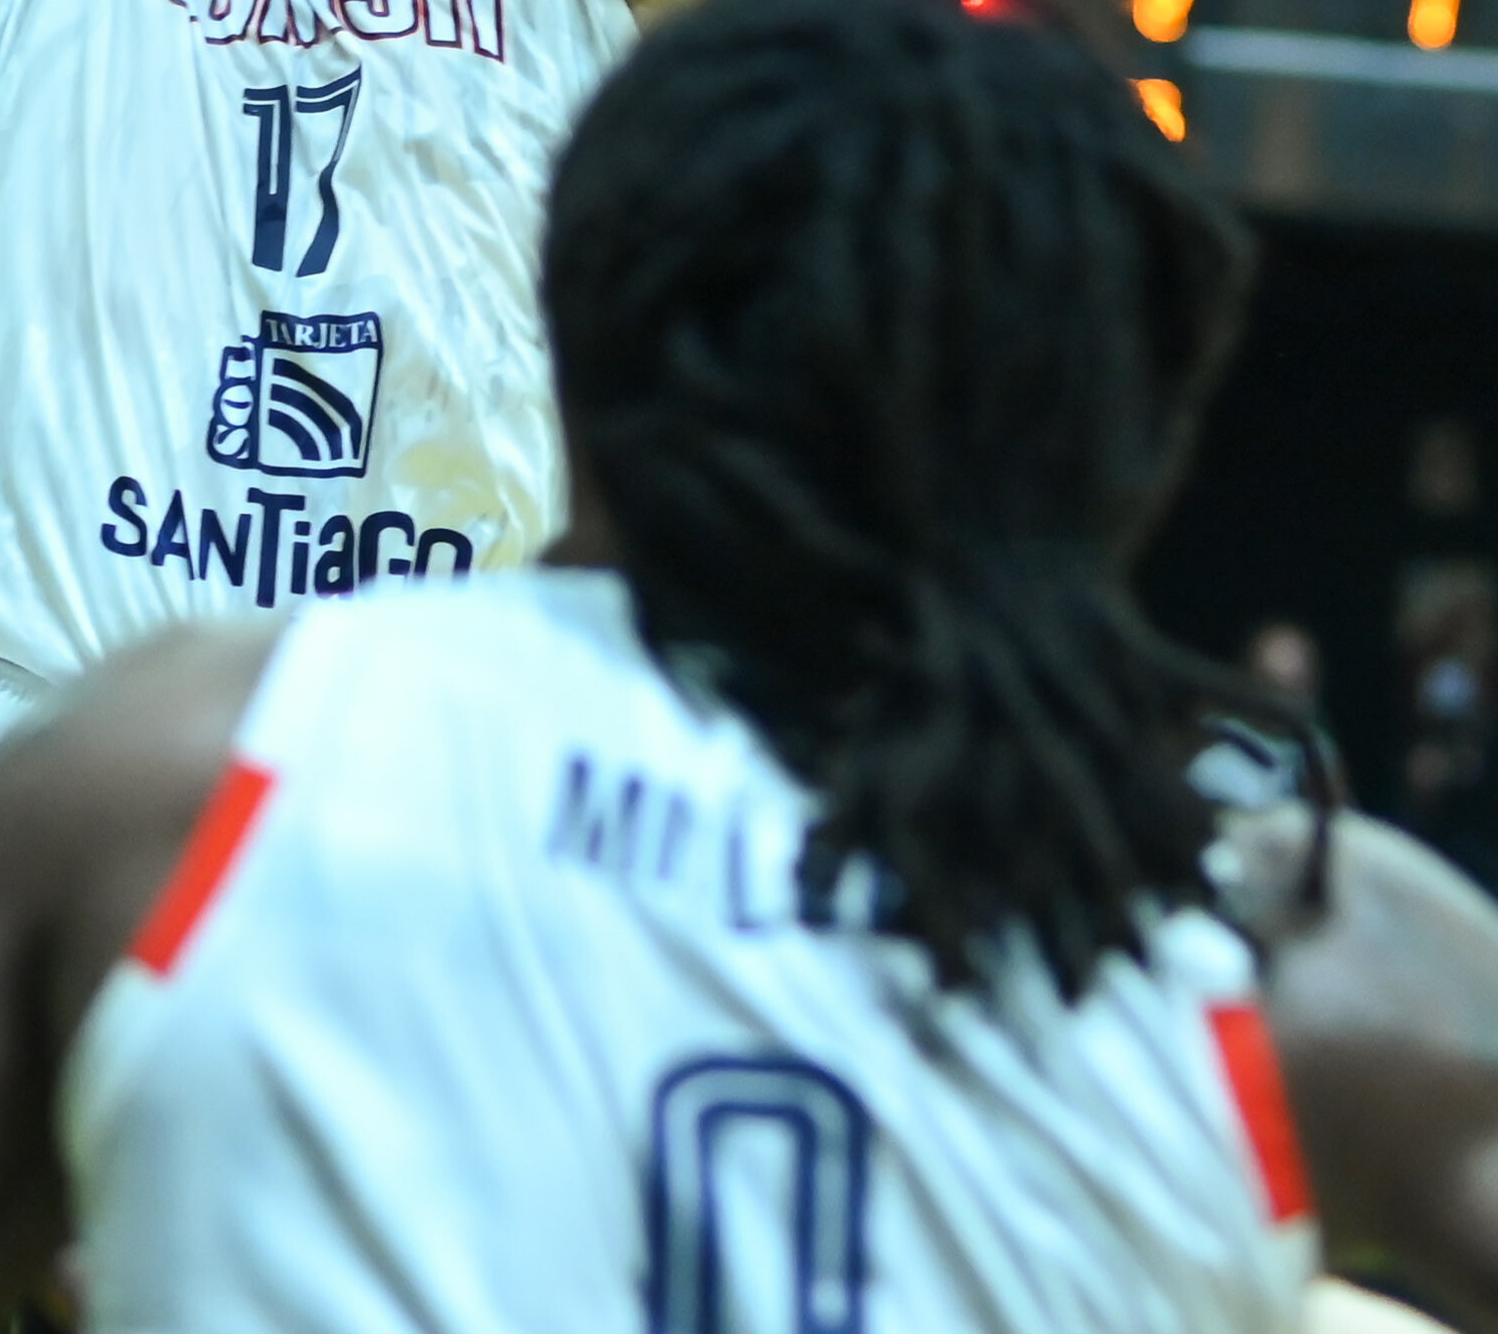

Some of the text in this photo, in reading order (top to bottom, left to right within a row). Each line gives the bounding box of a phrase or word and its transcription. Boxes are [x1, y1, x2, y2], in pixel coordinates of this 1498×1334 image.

[242, 63, 363, 278] 17
[265, 317, 380, 350] TARJETA
[642, 1054, 870, 1334] 0
